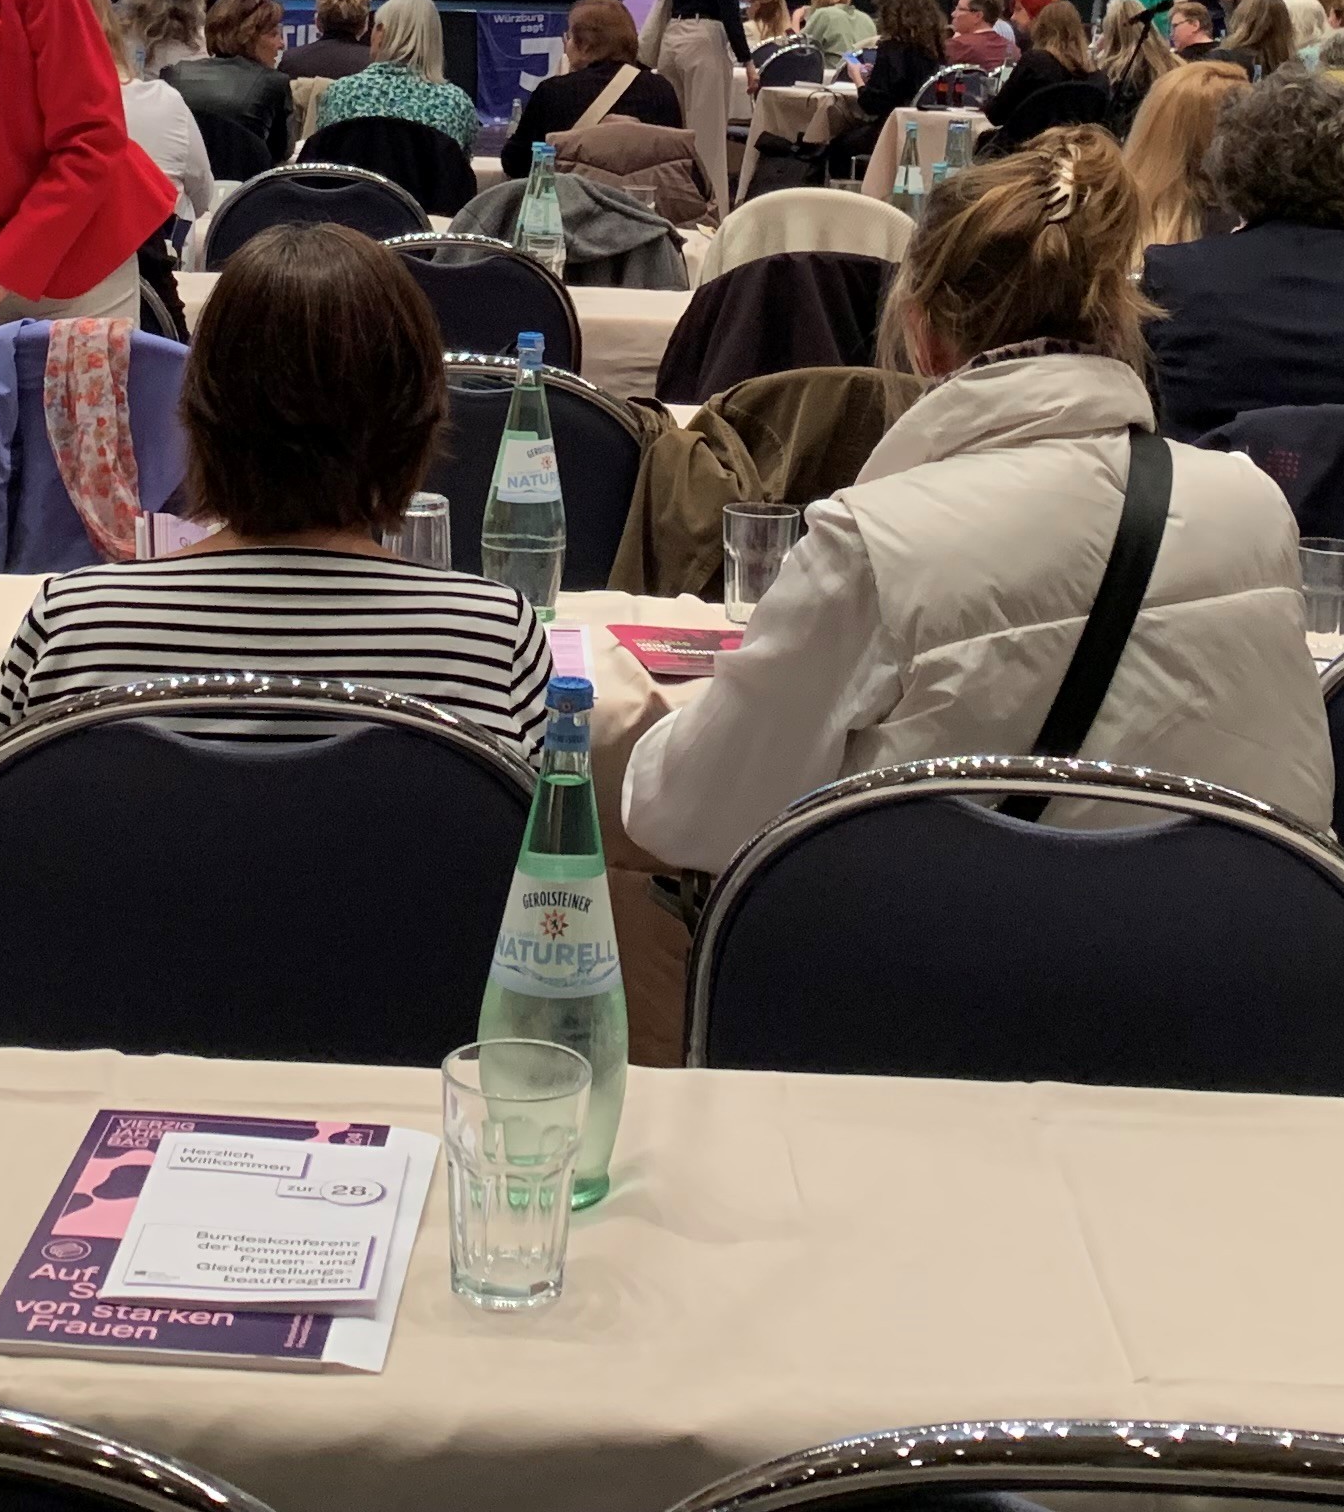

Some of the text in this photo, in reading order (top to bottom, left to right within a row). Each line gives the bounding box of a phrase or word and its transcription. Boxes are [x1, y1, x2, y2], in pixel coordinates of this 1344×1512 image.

[493, 14, 545, 23] Würzburg
[520, 23, 544, 33] sagt
[508, 472, 558, 488] NATUR
[523, 891, 592, 914] GEROLSTEINER
[497, 934, 615, 966] NATURELL
[118, 1119, 195, 1131] VIERZIG
[115, 1128, 163, 1140] JAHR
[107, 1137, 150, 1148] BAG
[182, 1147, 254, 1159] Herzlich
[179, 1156, 291, 1171] Willkommen
[287, 1184, 374, 1196] zur 28.
[196, 1231, 360, 1247] Bundeskonferenz
[197, 1241, 358, 1256] der kommunalen
[319, 1257, 357, 1266] und
[29, 1264, 100, 1281] Auf
[223, 1275, 351, 1285] beauftragten
[15, 1300, 234, 1327] von starken
[26, 1315, 158, 1341] Frauen
